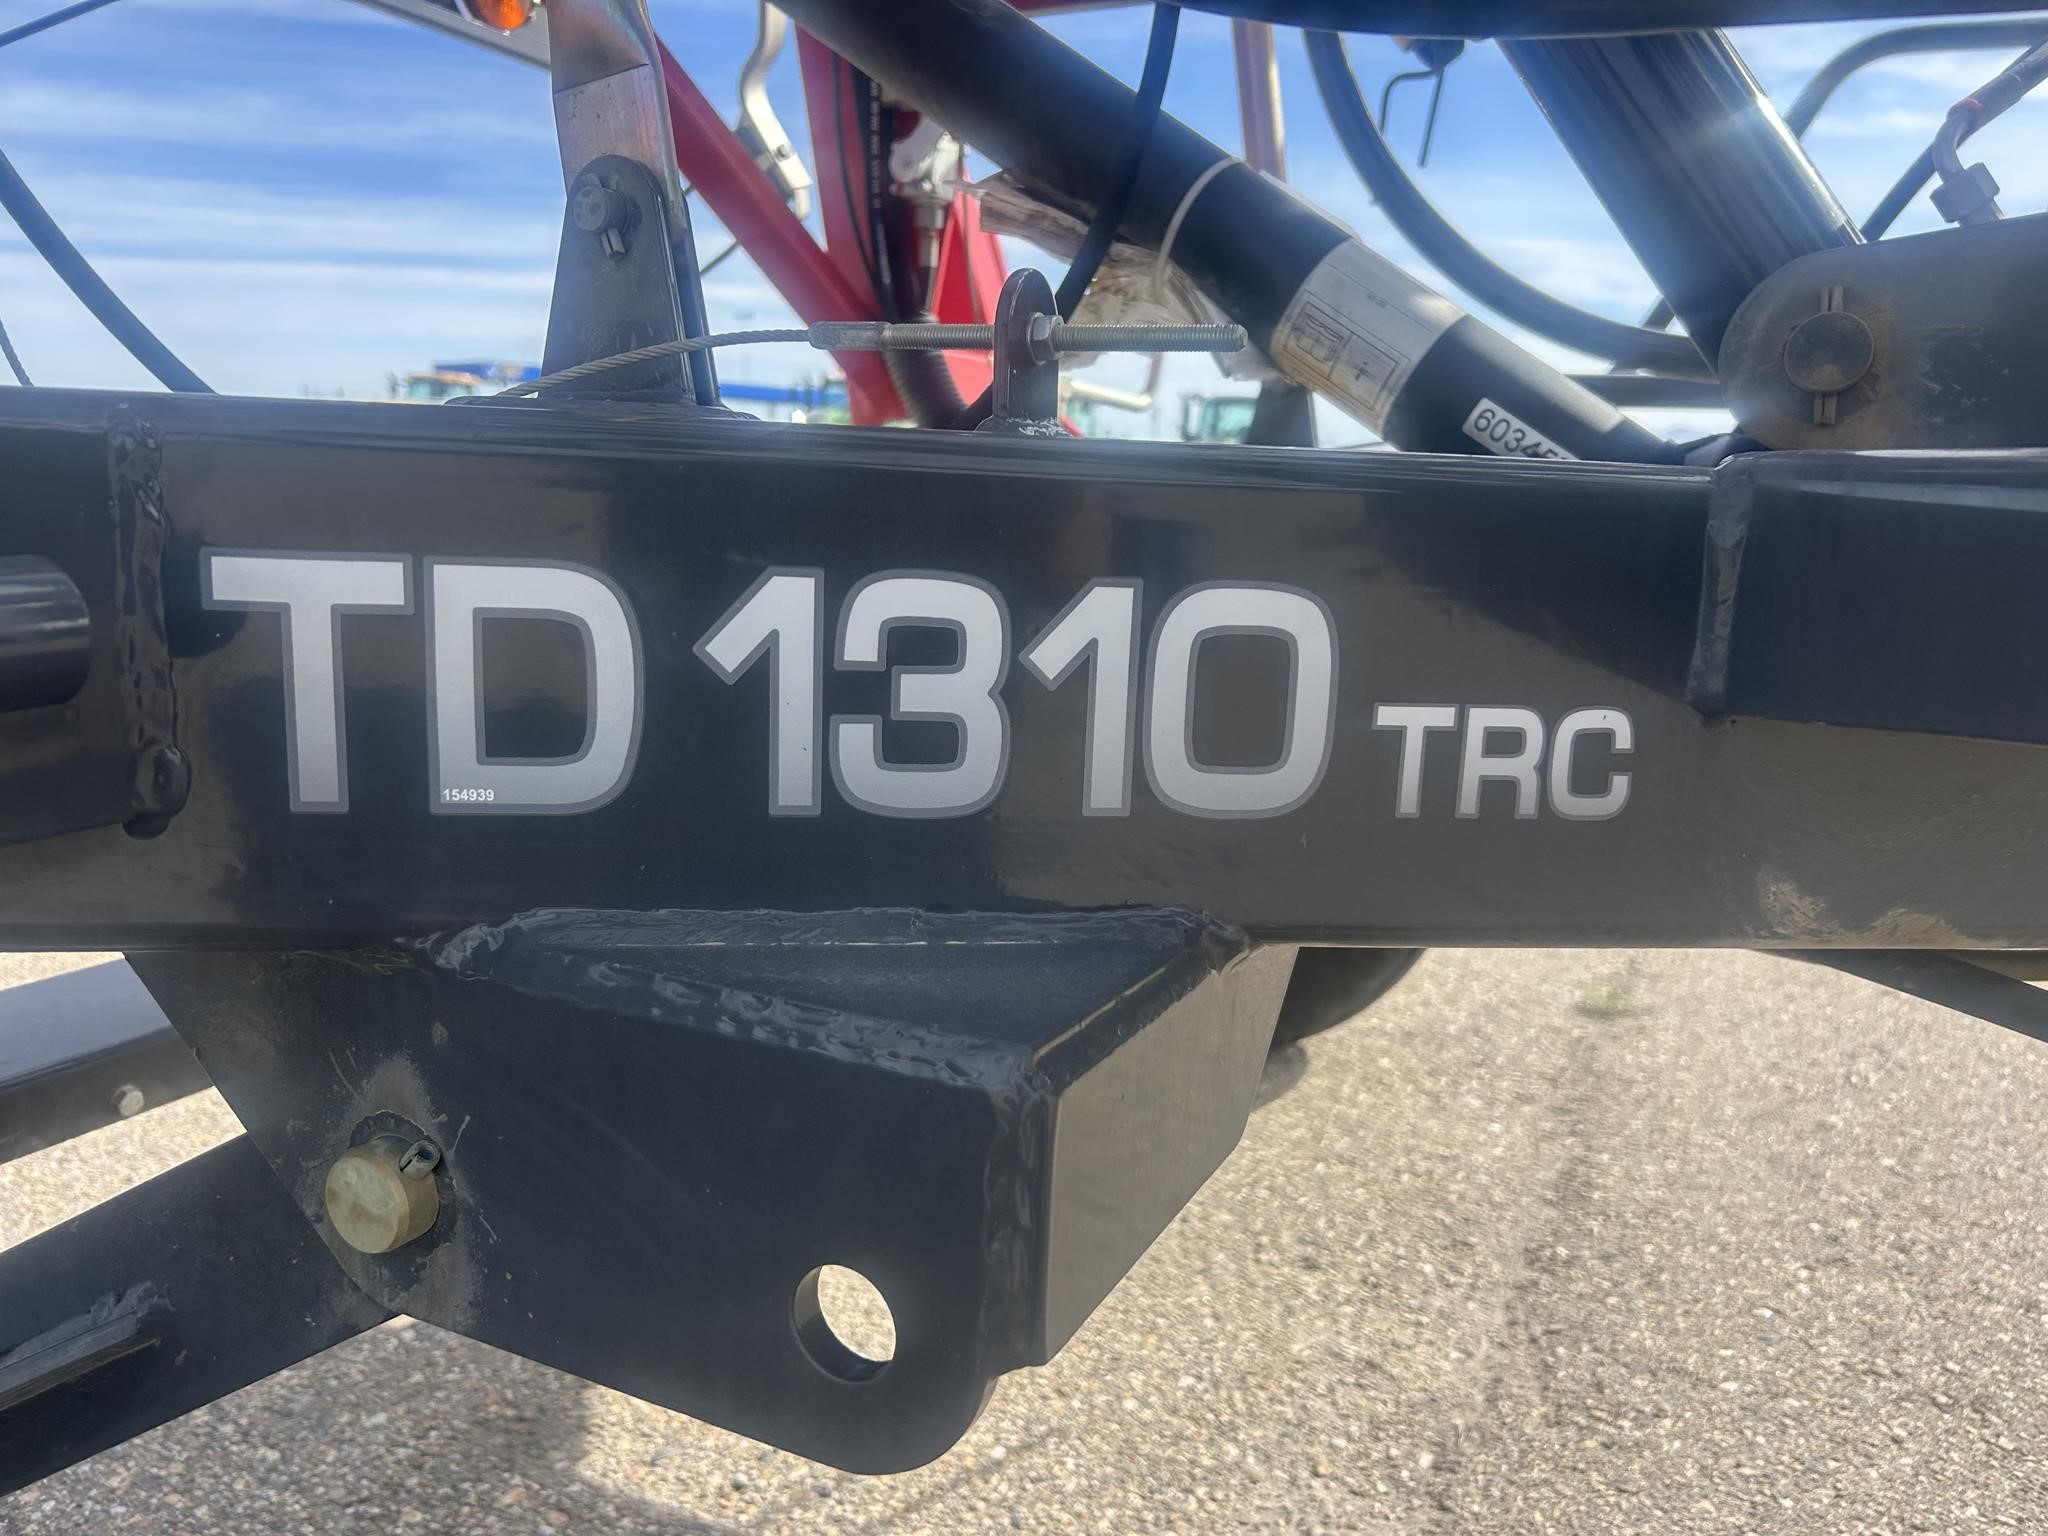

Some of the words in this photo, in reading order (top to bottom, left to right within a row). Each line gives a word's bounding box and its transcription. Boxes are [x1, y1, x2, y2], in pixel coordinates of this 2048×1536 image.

[1474, 408, 1568, 459] 6034
[203, 550, 642, 815] TD
[694, 567, 1338, 817] 1310
[1373, 703, 1634, 821] TRC
[442, 787, 496, 803] 154939
